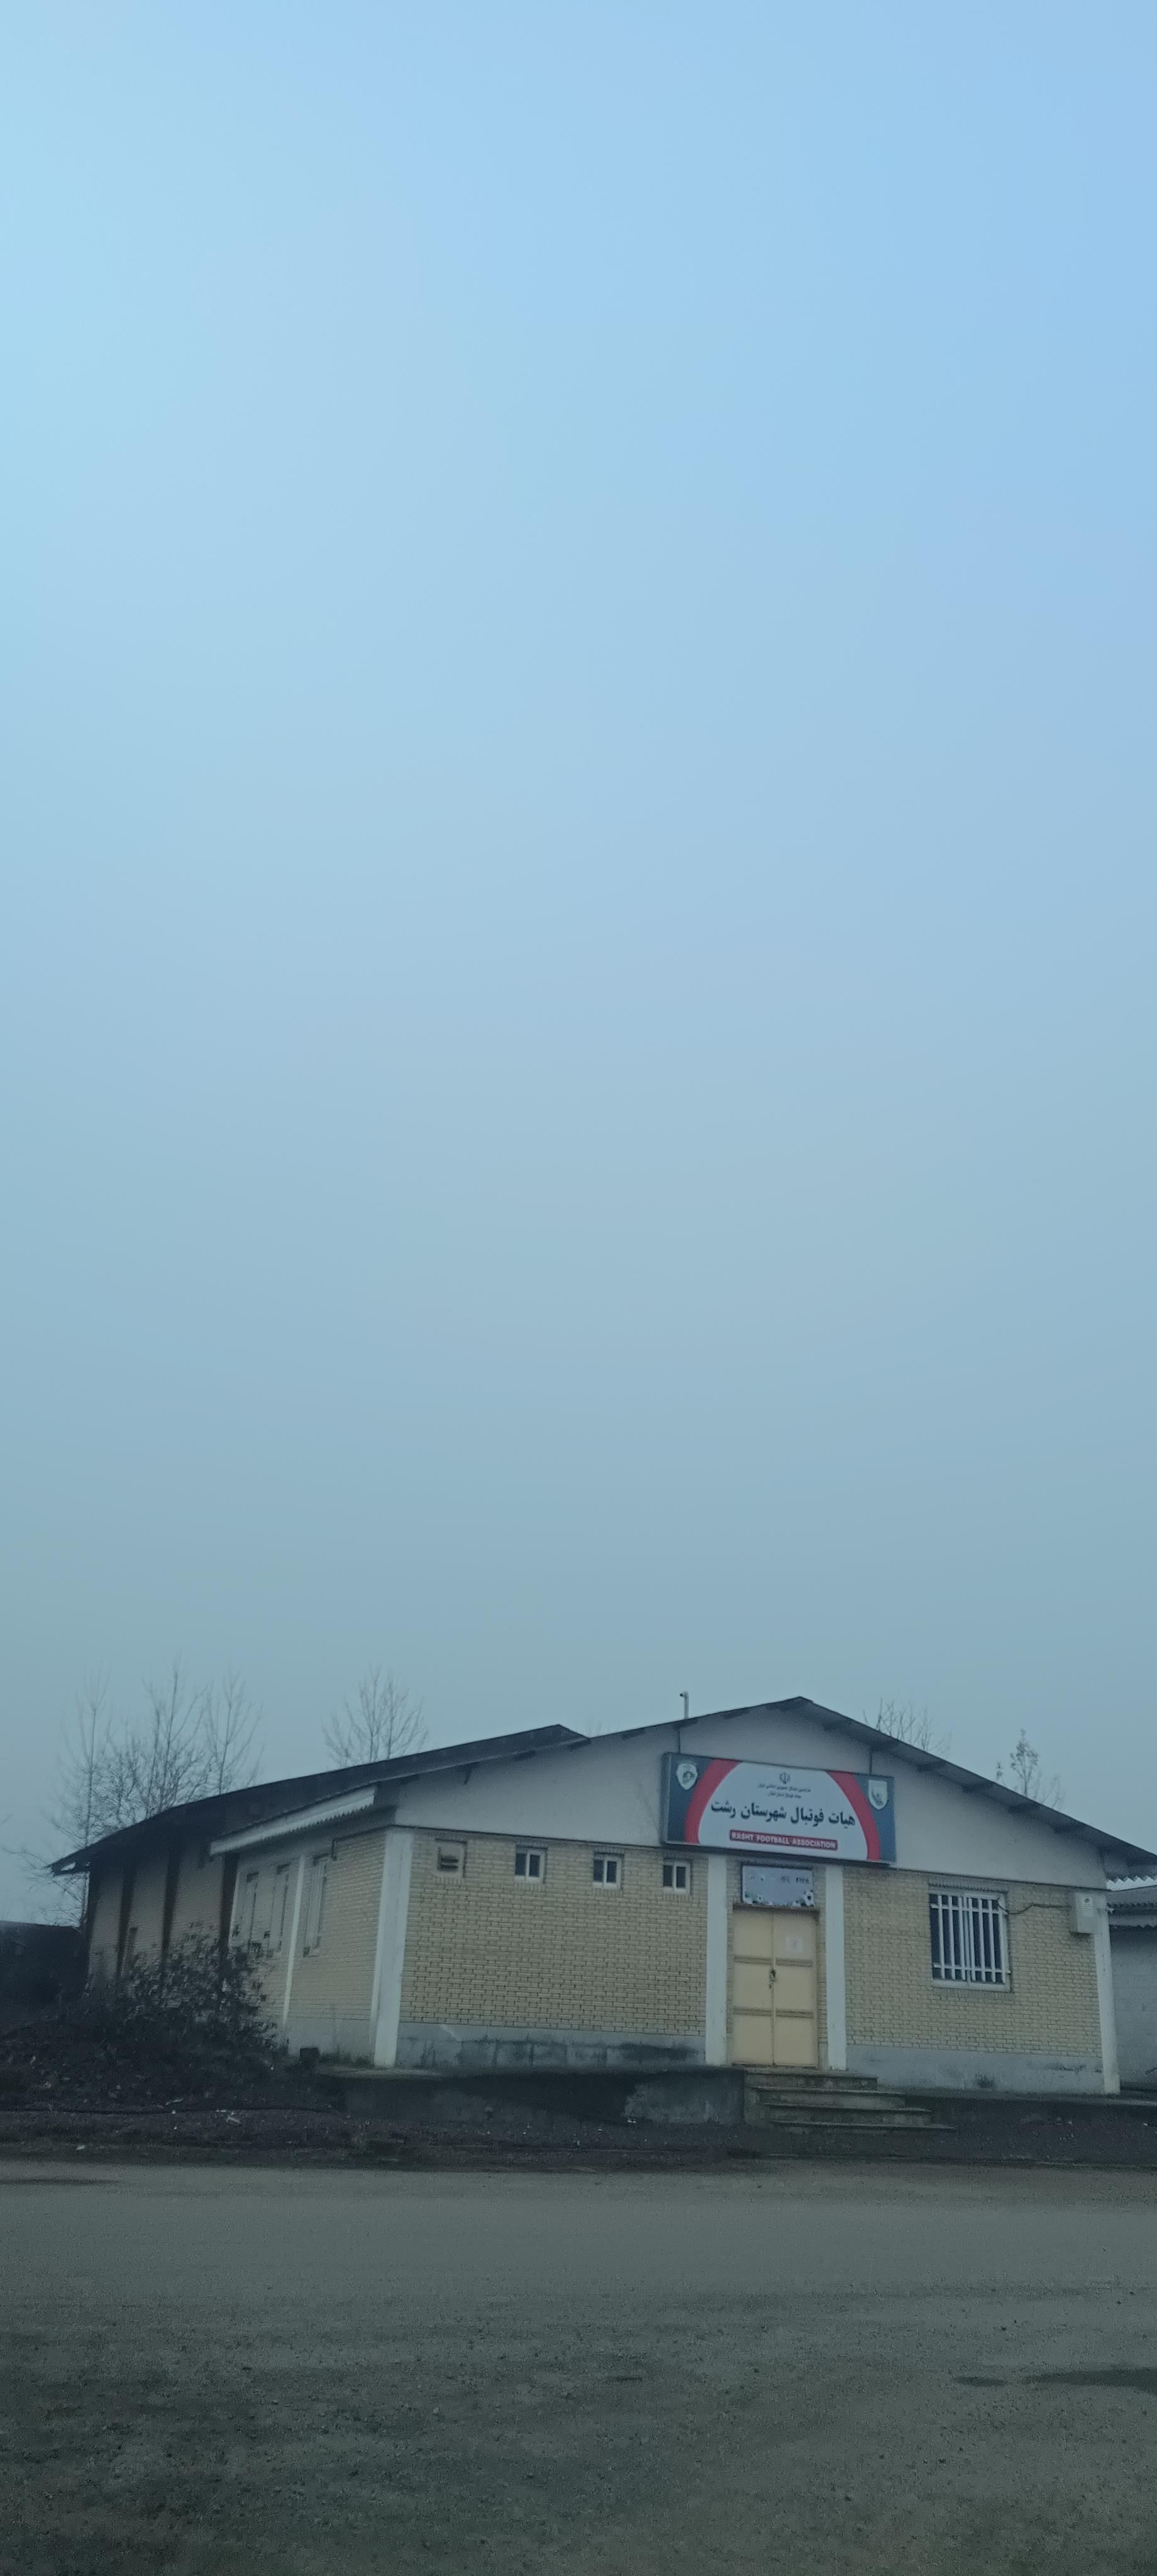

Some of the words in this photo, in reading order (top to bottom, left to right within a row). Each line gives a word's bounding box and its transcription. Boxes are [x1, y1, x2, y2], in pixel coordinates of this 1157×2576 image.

[711, 1801, 736, 1819] رشت
[741, 1802, 787, 1823] شهرستان
[790, 1807, 824, 1827] فوتبال
[828, 1811, 855, 1829] هیات
[731, 1831, 755, 1841] RASHT
[756, 1834, 789, 1845] FOOTBALL
[792, 1838, 836, 1849] ASSOCIATION
